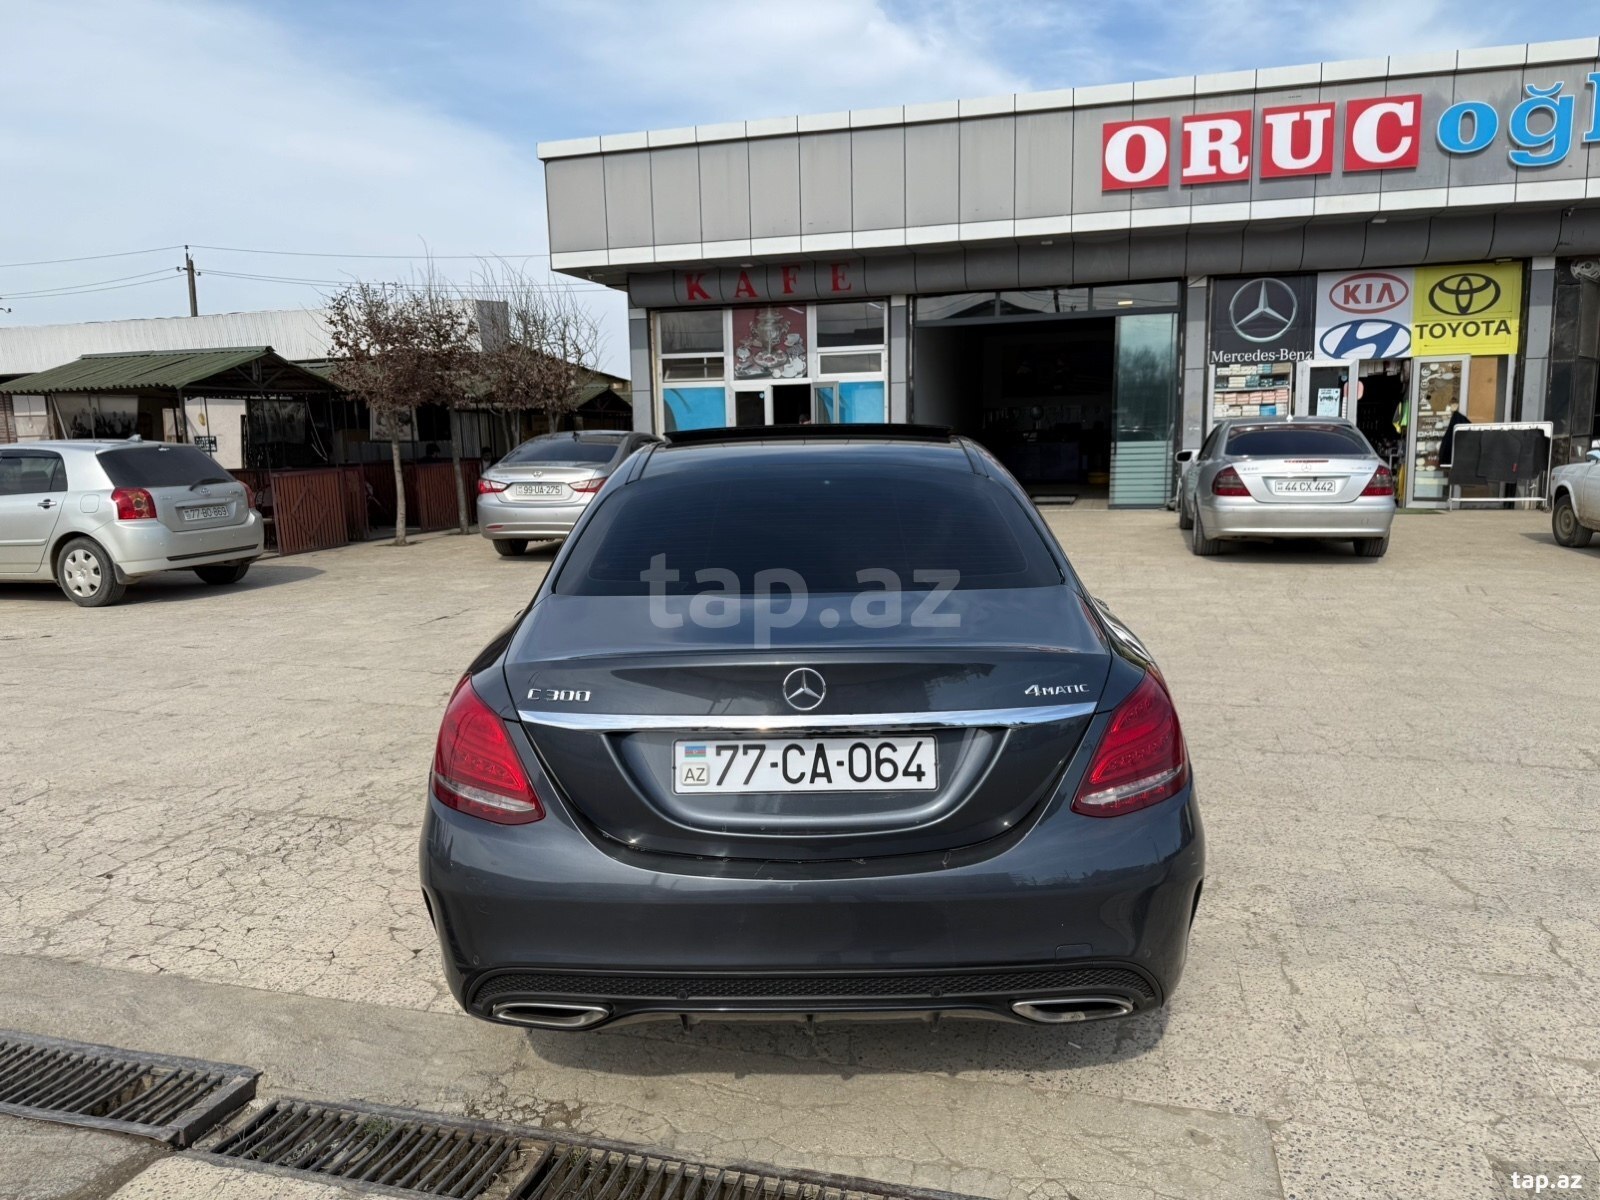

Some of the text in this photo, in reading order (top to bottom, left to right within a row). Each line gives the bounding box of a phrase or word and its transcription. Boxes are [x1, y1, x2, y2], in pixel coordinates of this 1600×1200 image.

[1104, 99, 1416, 183] ORUC
[684, 263, 852, 301] KAFE
[1343, 282, 1395, 305] KIA
[1414, 319, 1512, 340] TOYOTA
[1210, 348, 1313, 363] Mercedes-Benz
[546, 689, 591, 702] 300
[1024, 683, 1090, 697] 4MATIC
[683, 741, 926, 786] AZ 77-CA-064
